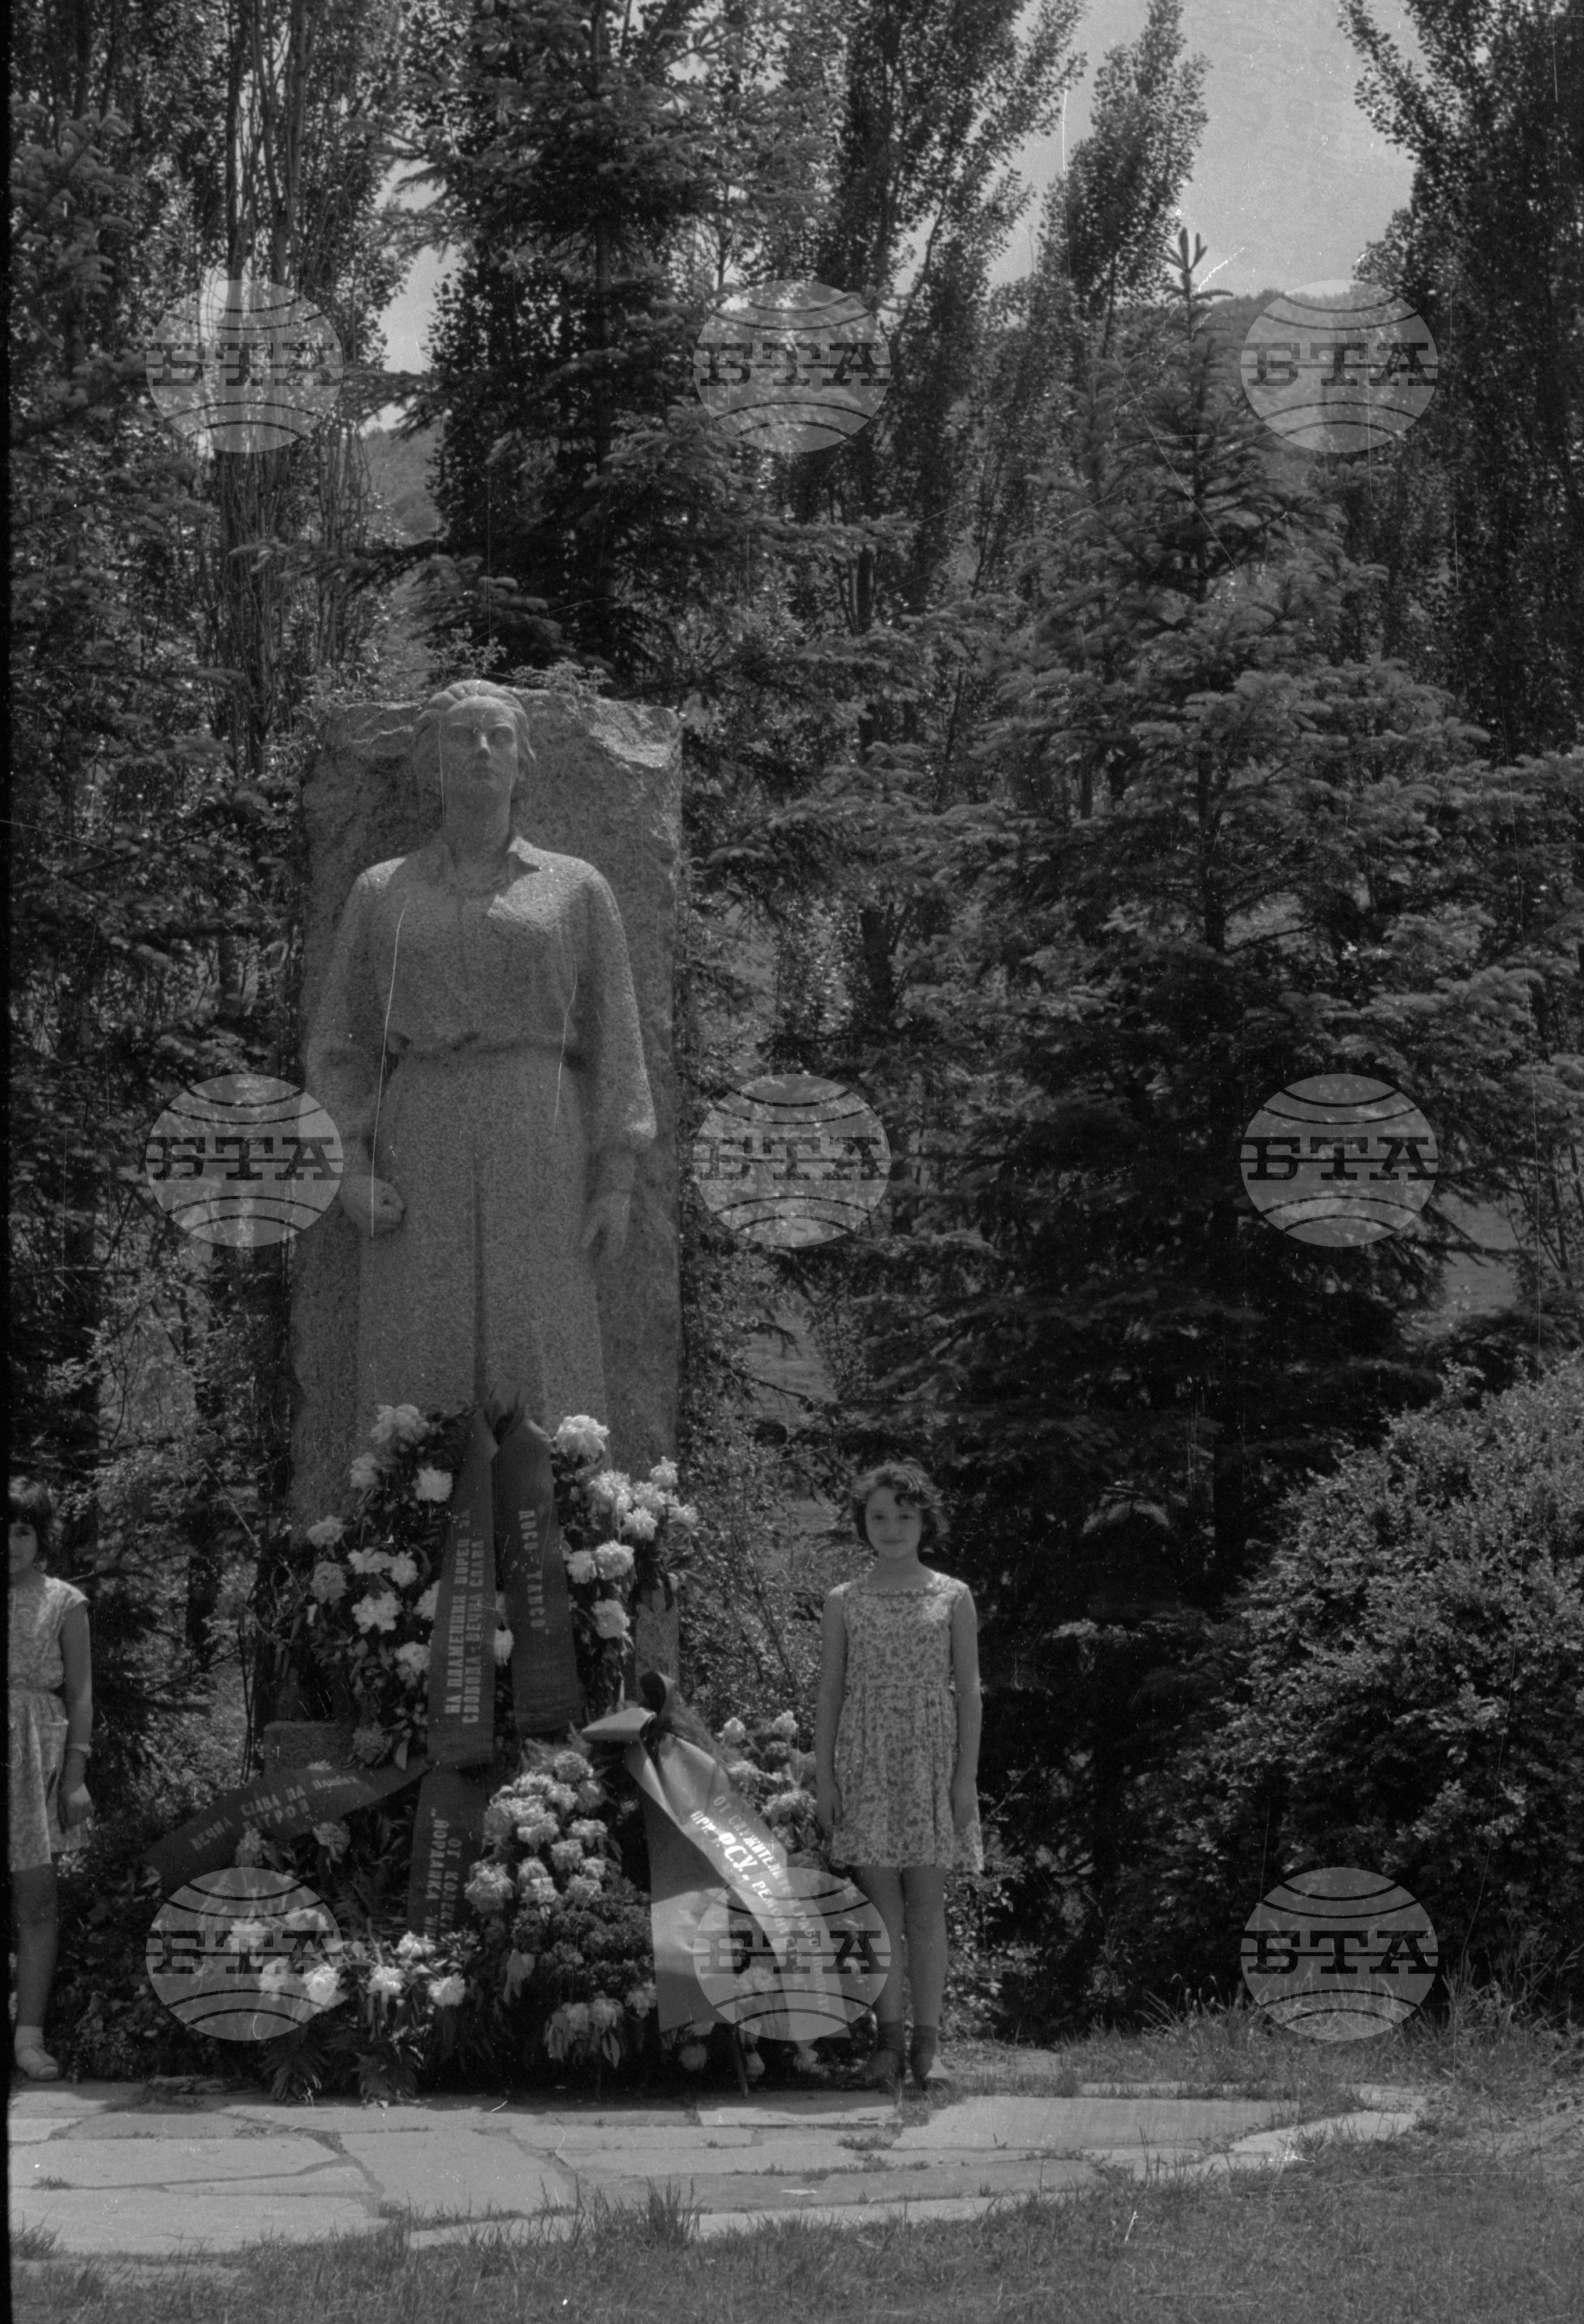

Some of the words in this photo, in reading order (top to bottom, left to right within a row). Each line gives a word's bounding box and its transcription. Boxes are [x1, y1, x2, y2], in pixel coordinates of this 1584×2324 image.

[517, 1509, 539, 1551] ДОСО
[454, 1537, 470, 1584] БОРЕЦ
[470, 1540, 484, 1587] СЛАВА
[446, 1594, 466, 1687] ПЛАМЕННИЯ
[465, 1593, 483, 1641] ВЕЧНА
[445, 1694, 461, 1713] НА
[463, 1656, 481, 1723] СВОБОДА
[188, 1815, 233, 1851] ВЕЧНА
[284, 1784, 306, 1801] НА
[712, 1794, 732, 1813] ОТ
[446, 1837, 462, 1858] ОТ
